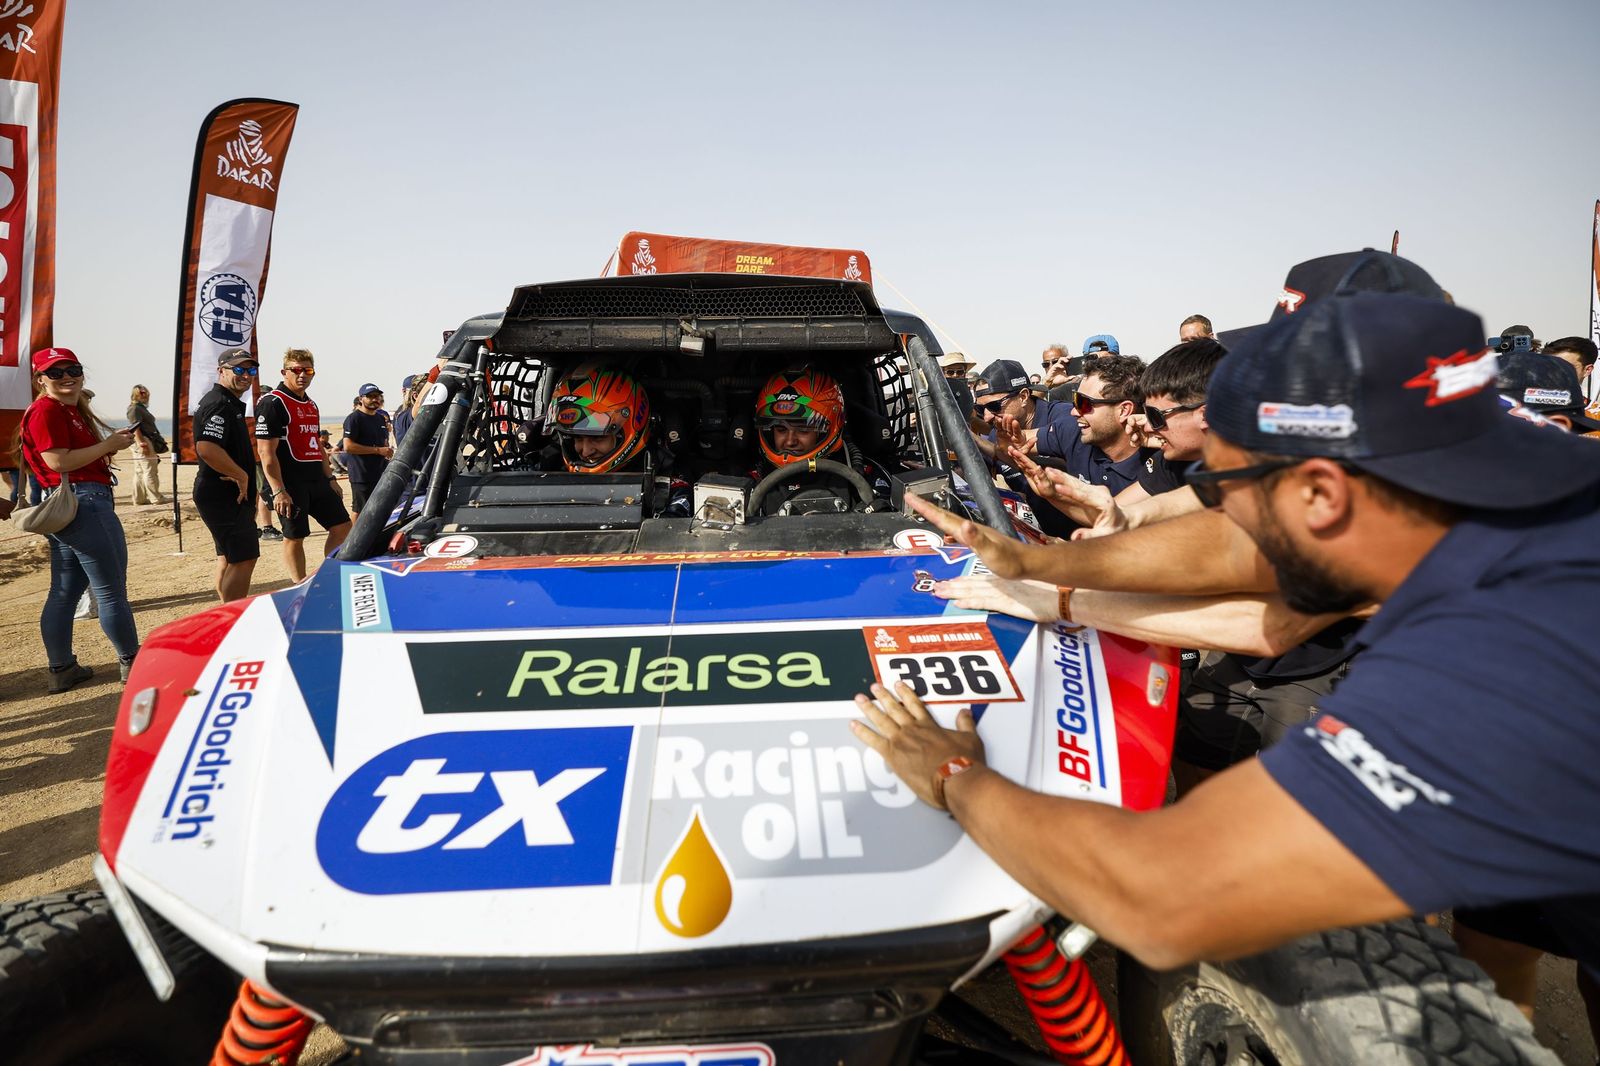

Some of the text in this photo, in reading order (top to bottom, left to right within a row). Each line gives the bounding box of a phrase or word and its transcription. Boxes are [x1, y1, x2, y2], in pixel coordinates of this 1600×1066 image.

[217, 155, 275, 191] DAKAR
[736, 255, 775, 265] DREAM.
[736, 264, 766, 274] DARE.
[202, 430, 223, 439] IVECO
[308, 436, 318, 450] 4
[438, 541, 466, 553] E
[907, 534, 932, 548] E
[354, 594, 377, 627] RENTAL
[908, 632, 983, 644] SAUDI ARABIA
[506, 647, 831, 697] Ralarsa
[889, 655, 1002, 697] 336
[171, 661, 265, 841] BFGoodrich
[652, 731, 917, 808] Racing
[356, 758, 608, 854] tx
